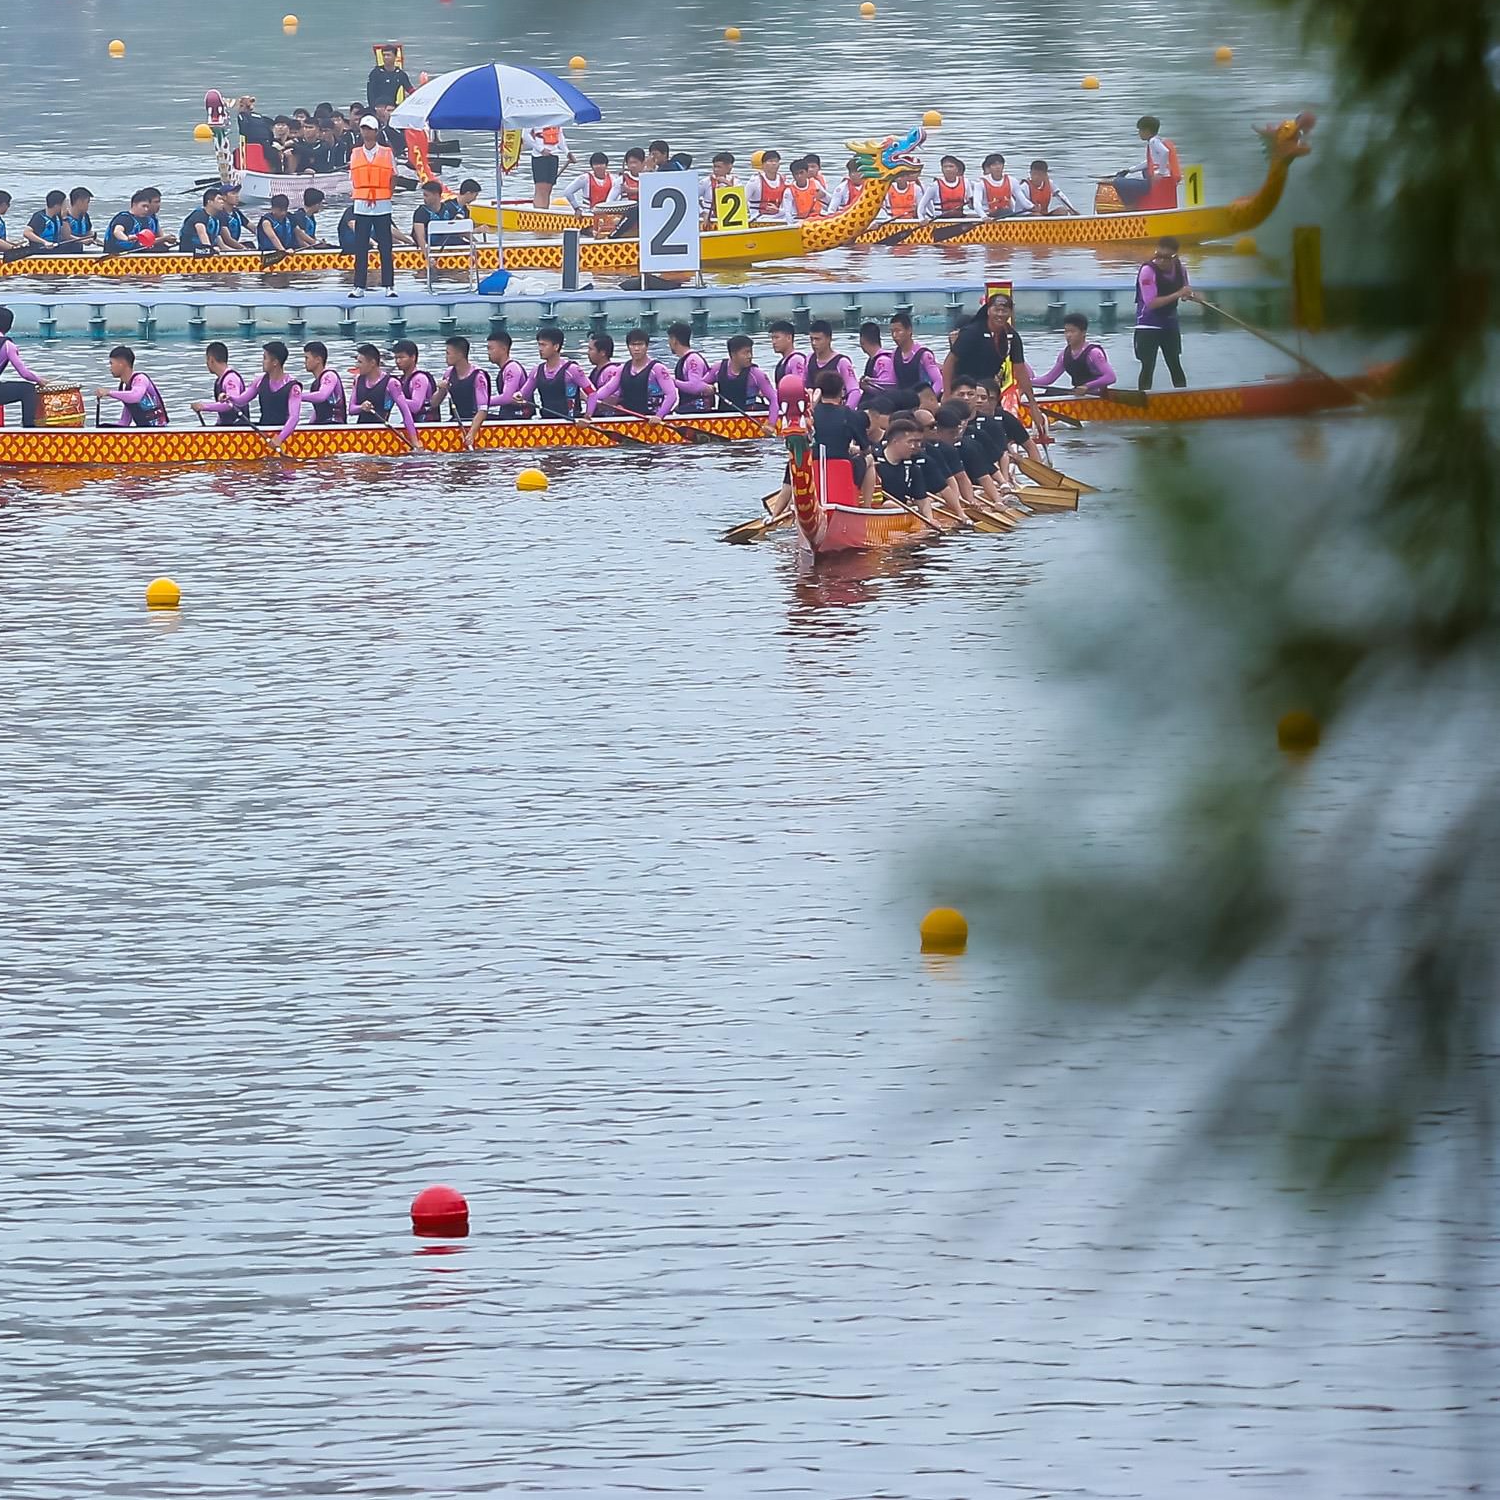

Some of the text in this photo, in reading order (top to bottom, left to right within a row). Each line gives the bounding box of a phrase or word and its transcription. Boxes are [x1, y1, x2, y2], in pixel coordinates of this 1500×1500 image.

[1189, 172, 1198, 204] 1
[650, 187, 688, 255] 2
[721, 193, 742, 227] 2
